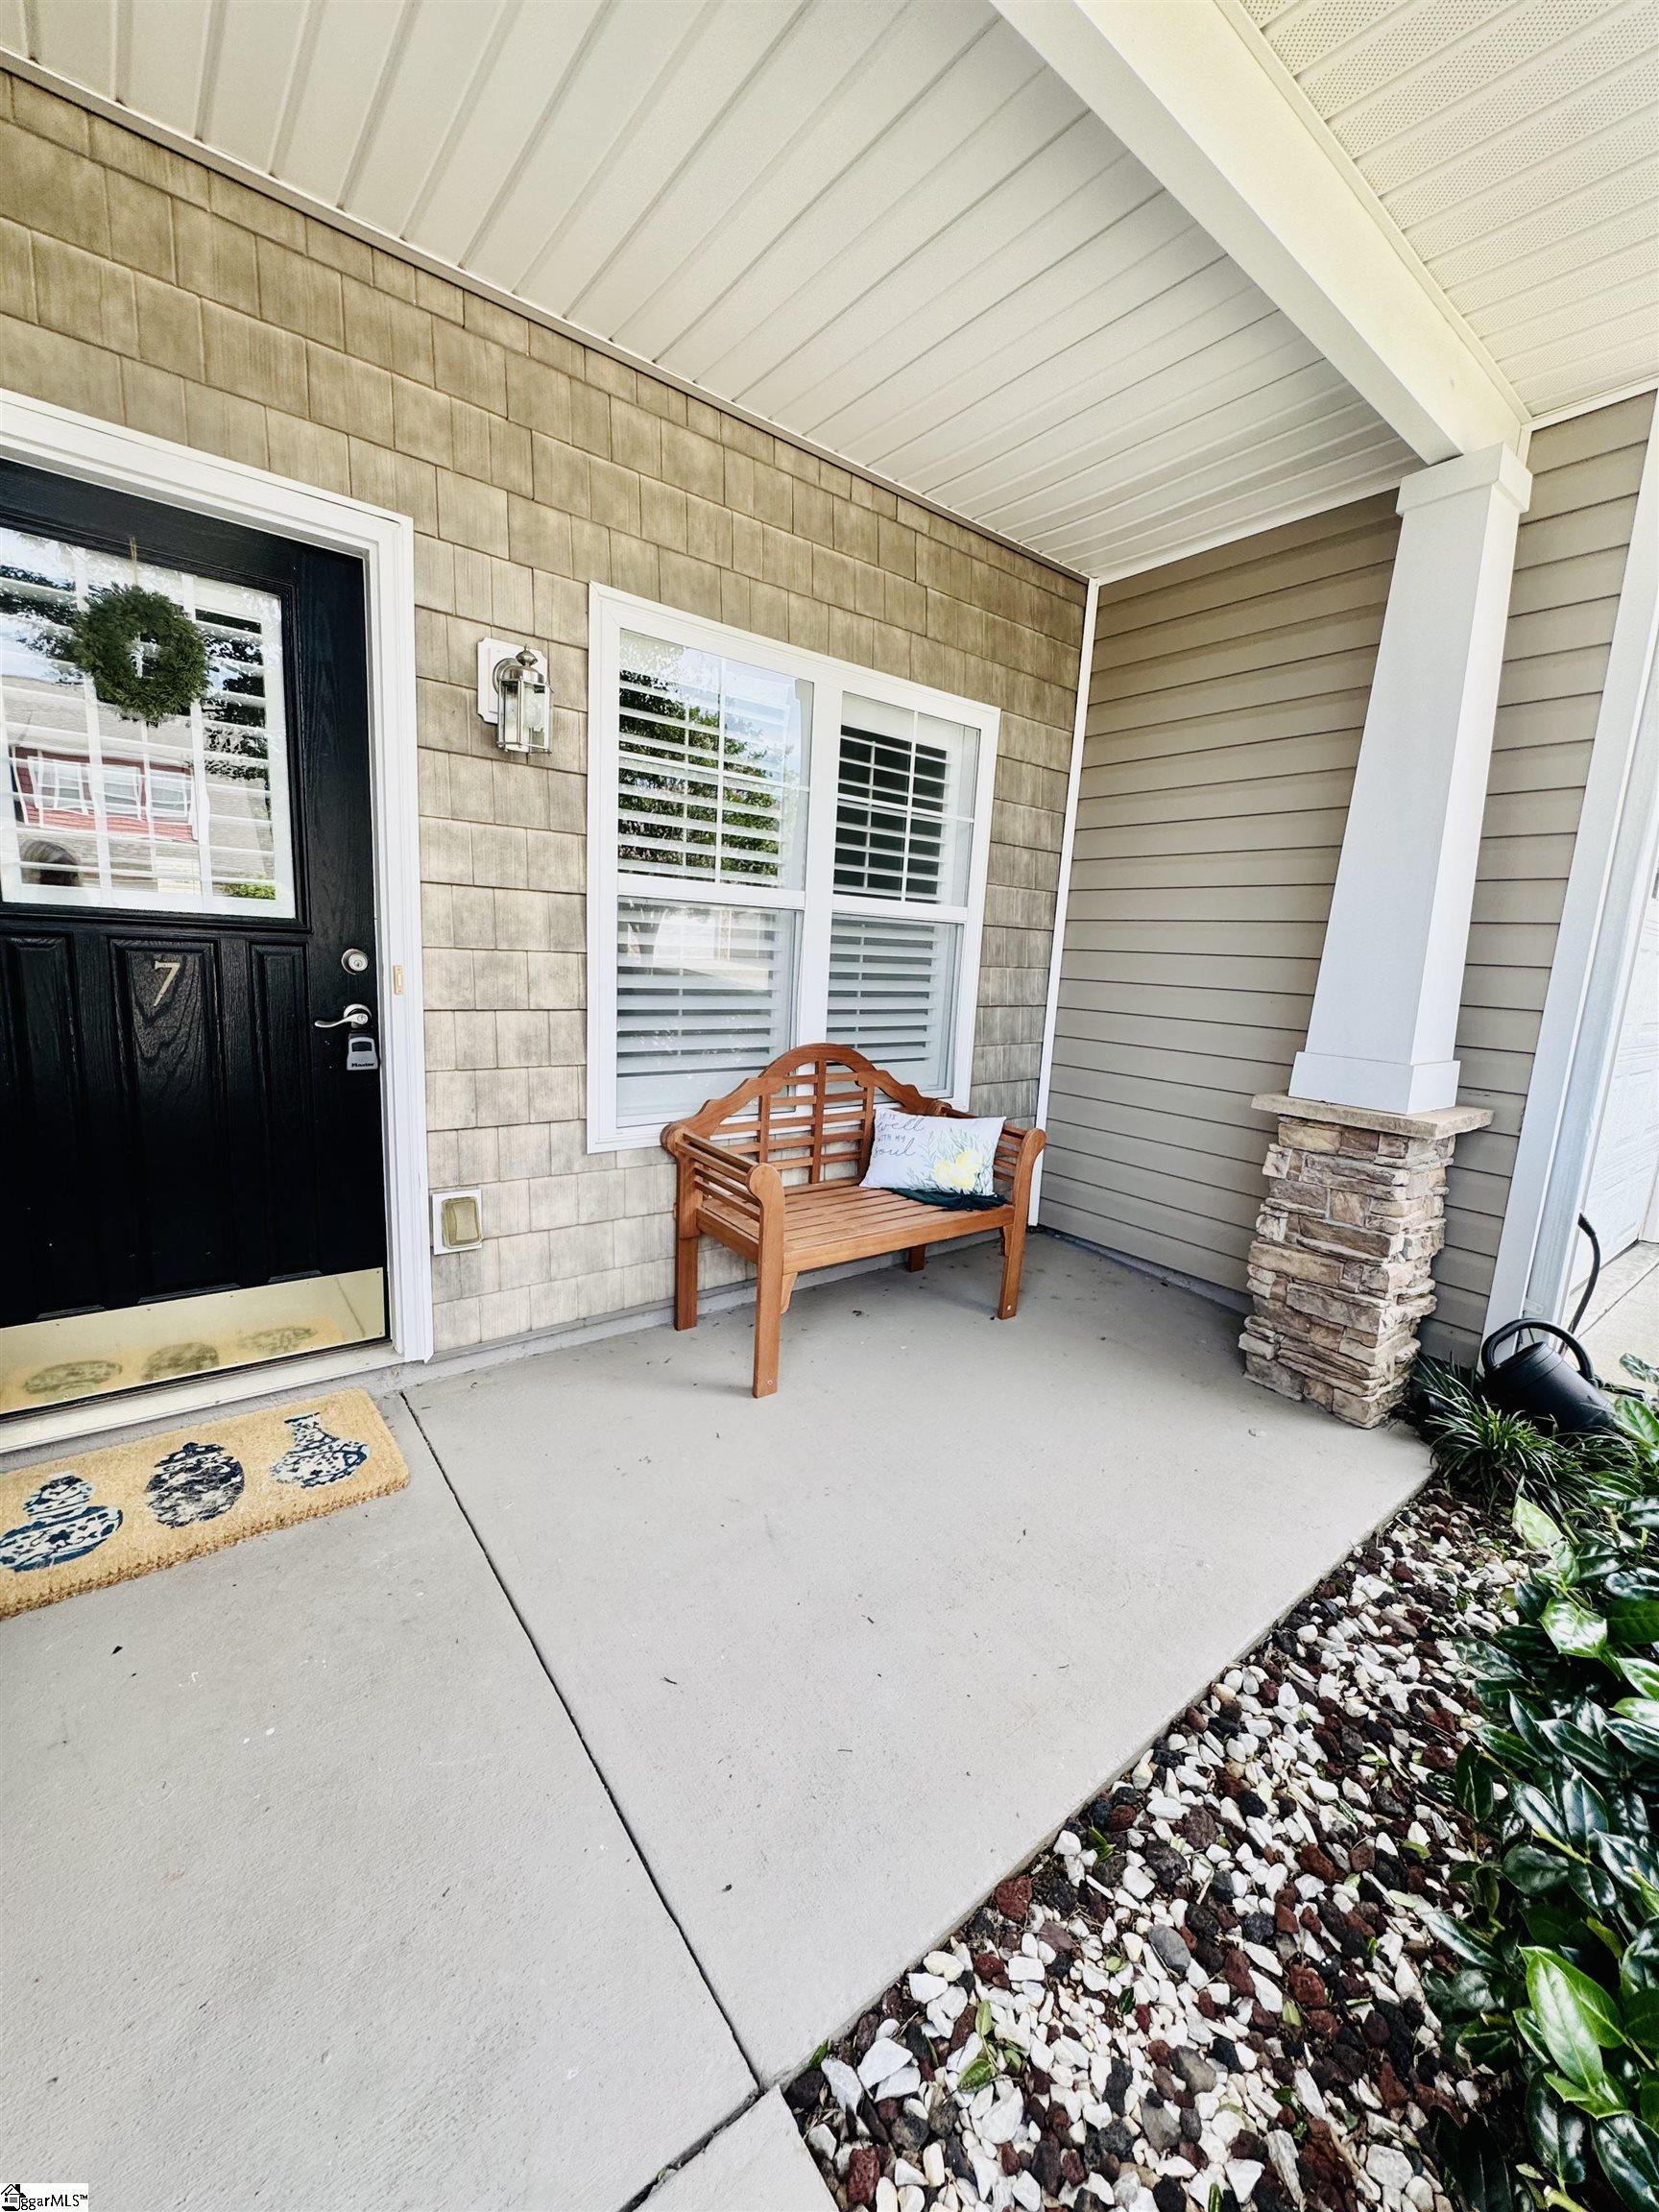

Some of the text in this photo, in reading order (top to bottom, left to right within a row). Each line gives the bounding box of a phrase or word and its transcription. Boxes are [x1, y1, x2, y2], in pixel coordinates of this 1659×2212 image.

[154, 960, 180, 1007] 7
[877, 1118, 925, 1132] well
[873, 1137, 916, 1158] soul
